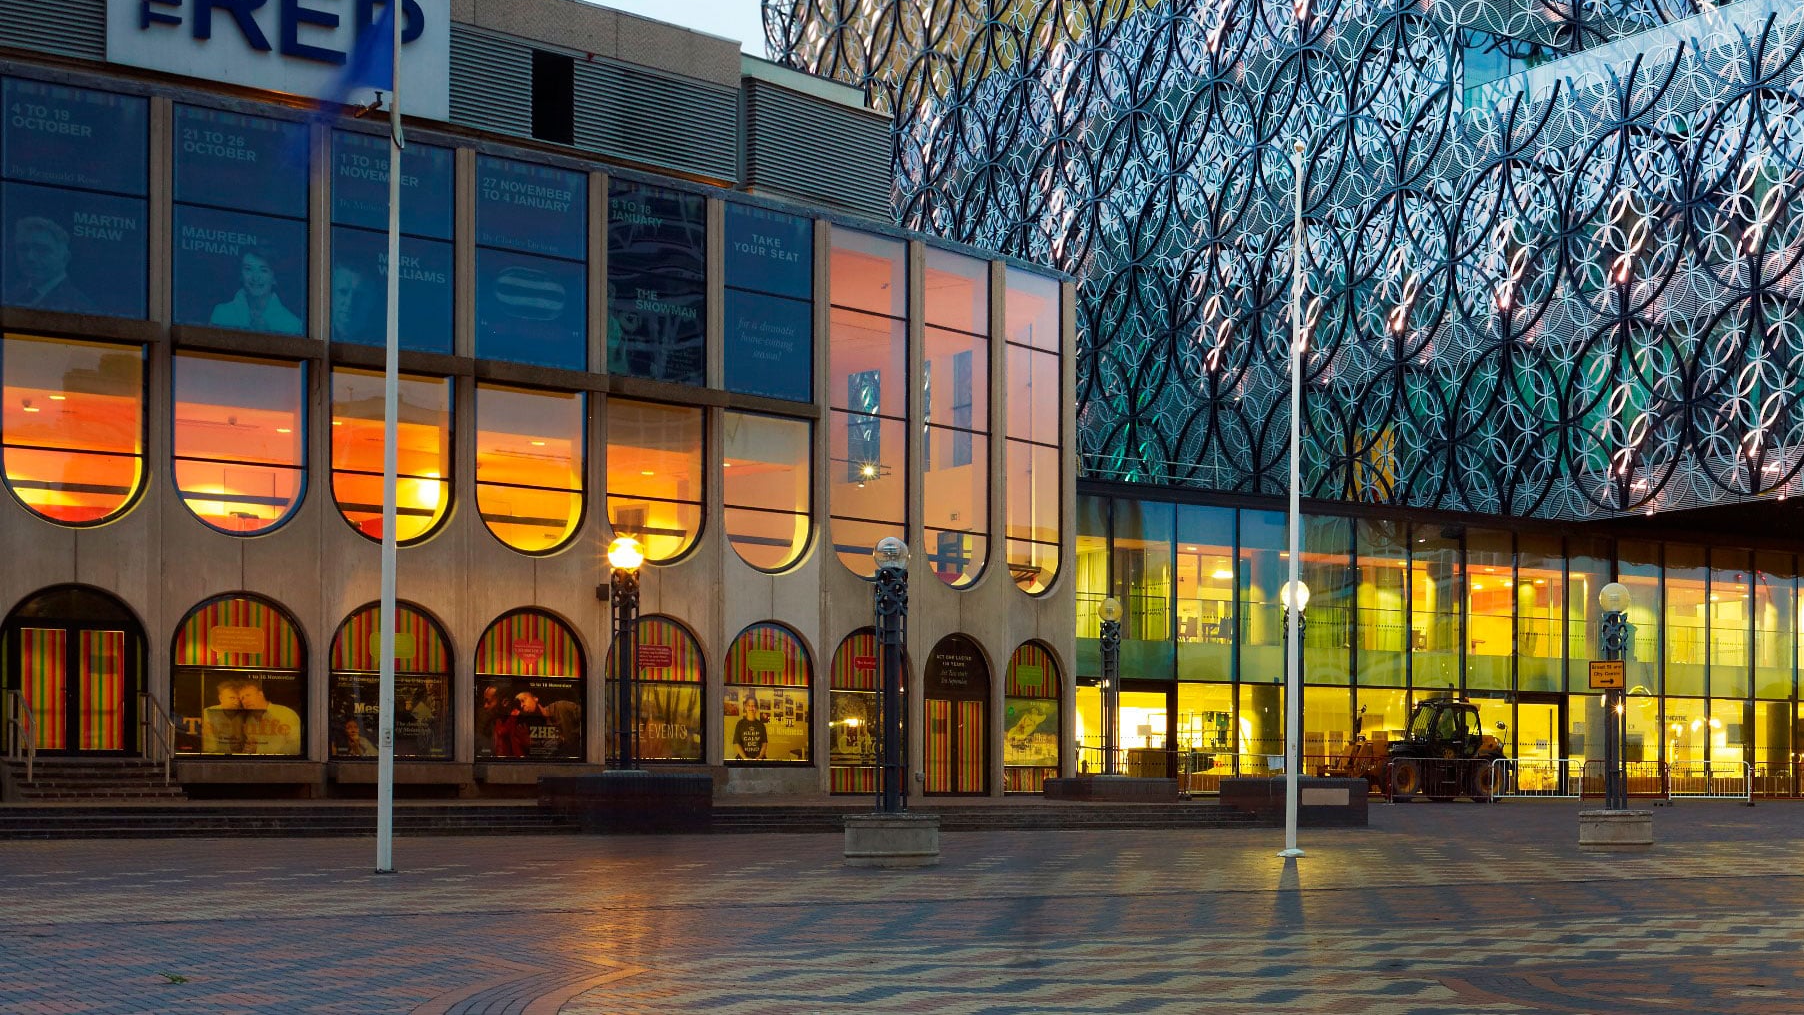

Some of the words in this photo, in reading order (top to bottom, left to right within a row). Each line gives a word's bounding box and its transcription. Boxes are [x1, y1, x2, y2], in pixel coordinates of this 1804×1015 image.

[11, 102, 21, 115] 4
[24, 103, 47, 118] TO
[12, 115, 92, 138] OCTOBER
[183, 128, 198, 141] 21
[203, 130, 224, 144] TO
[227, 135, 245, 147] 26
[183, 141, 257, 162] OCTOBER
[352, 154, 369, 168] TO
[340, 164, 419, 188] NOVEMER
[482, 177, 496, 187] 27
[500, 179, 573, 201] NOVEMBER
[482, 188, 499, 201] TO
[503, 191, 510, 201] 4
[513, 192, 571, 213] JANUARY
[621, 200, 635, 211] TO
[73, 212, 136, 230] MARTIN
[612, 211, 664, 228] JANUARY
[73, 225, 122, 242] SHAW
[182, 225, 257, 246] MAUREEN
[752, 234, 781, 247] TAKE
[182, 240, 239, 257] LIPMAN
[734, 241, 766, 256] YOUR
[770, 249, 799, 263] SEAT
[378, 252, 420, 269] MRK
[376, 264, 446, 284] WLLIAMS
[636, 288, 658, 301] THE
[635, 300, 697, 319] SNOWMAN
[354, 702, 380, 714] Mes
[649, 723, 688, 740] EVENTS
